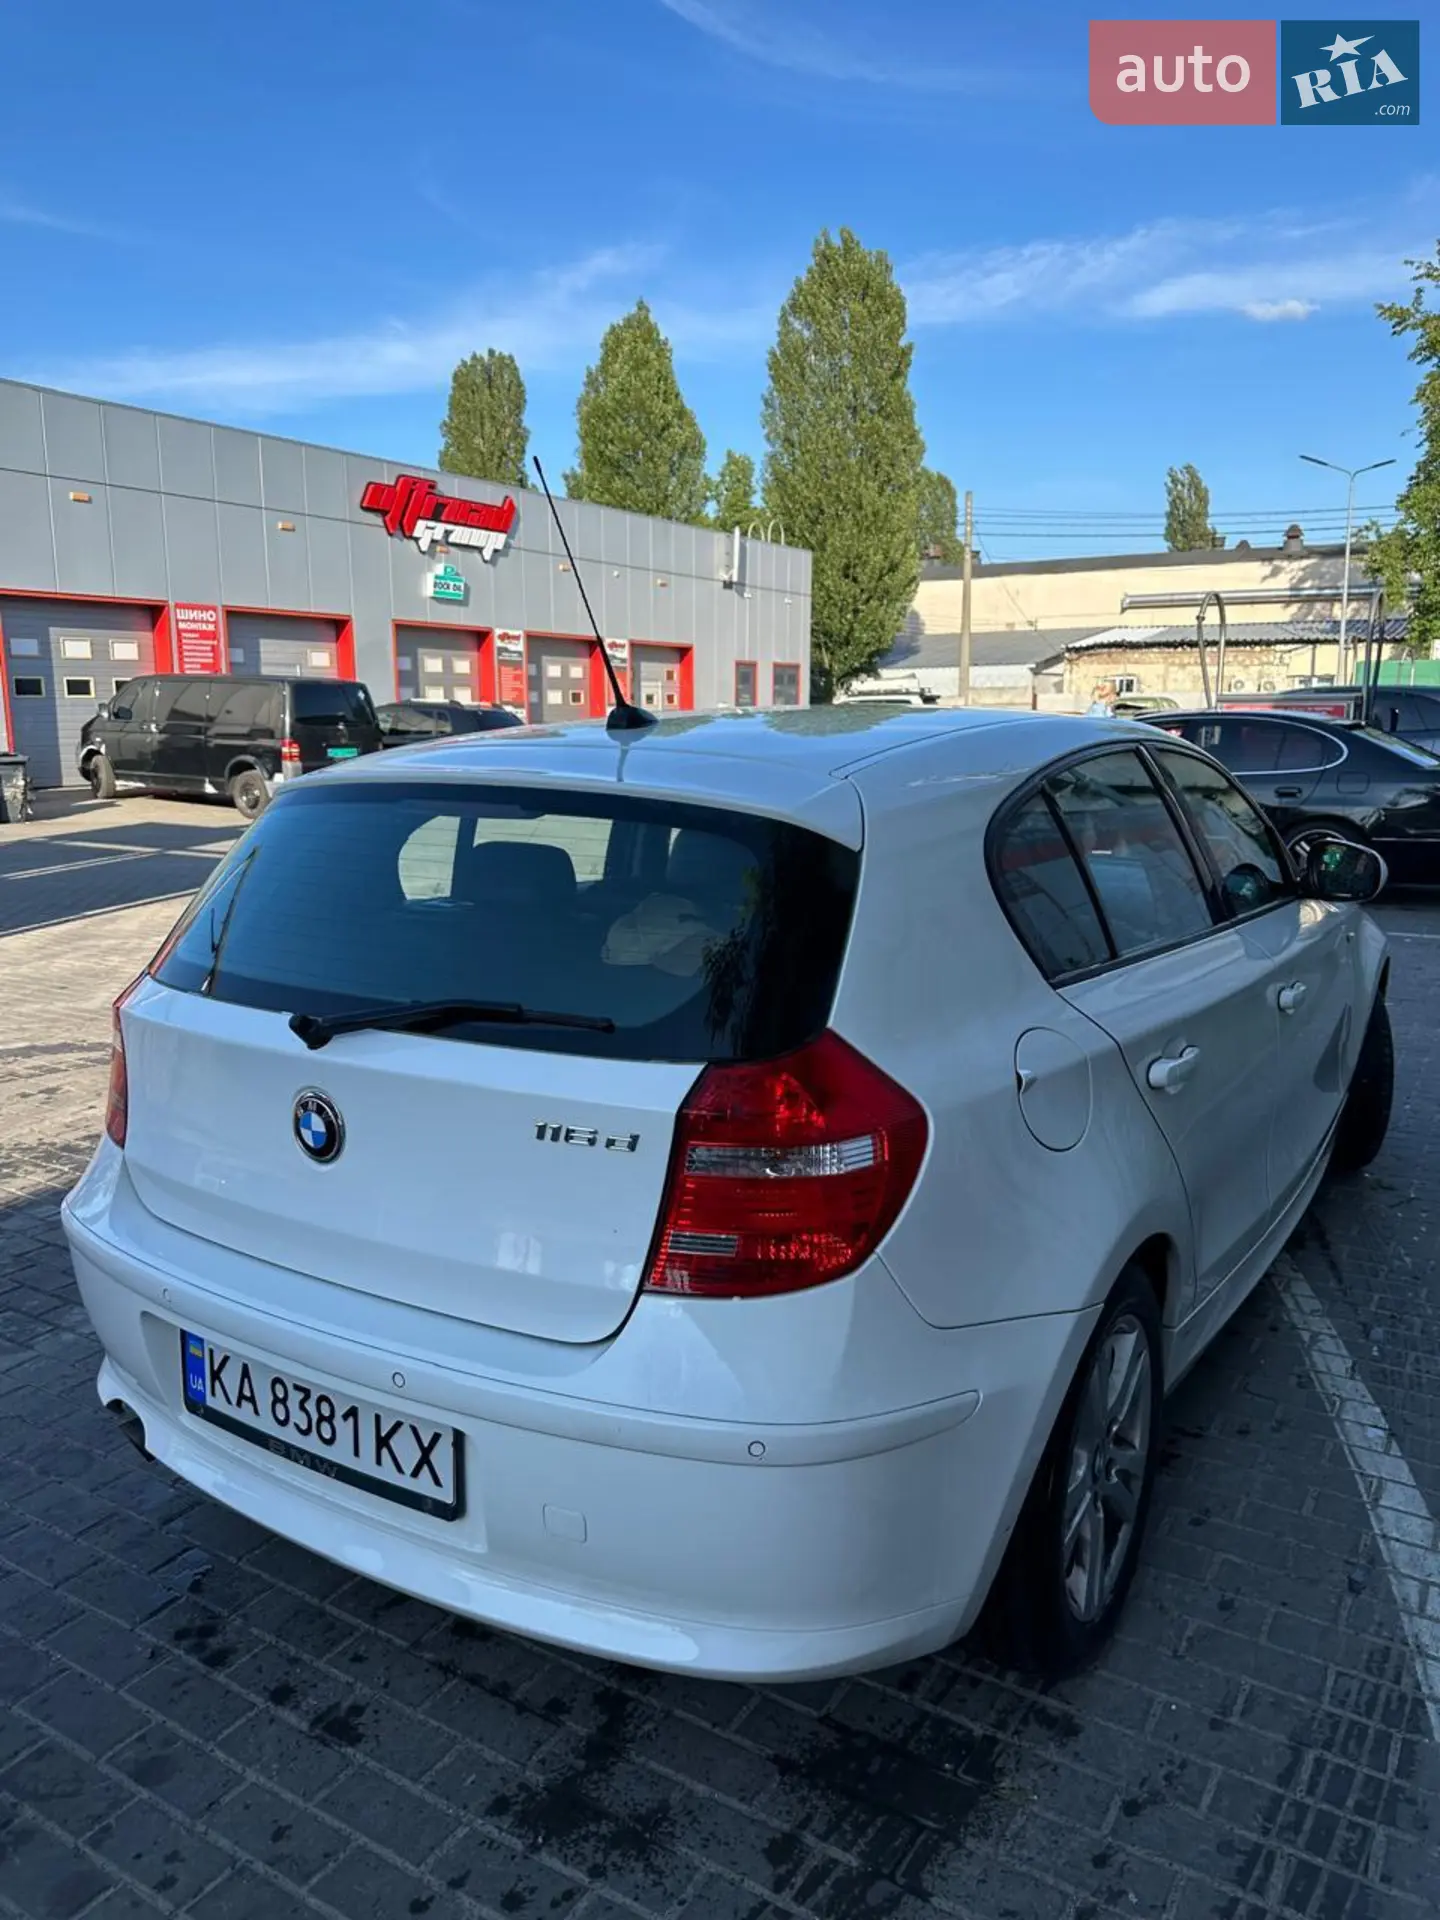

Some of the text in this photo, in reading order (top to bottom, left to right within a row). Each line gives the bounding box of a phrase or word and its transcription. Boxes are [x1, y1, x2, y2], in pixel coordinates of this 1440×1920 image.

[176, 608, 216, 621] ШИНО
[178, 621, 216, 631] МОНТАЖ
[190, 1373, 205, 1393] UA
[208, 1347, 444, 1489] KA 8381 KX
